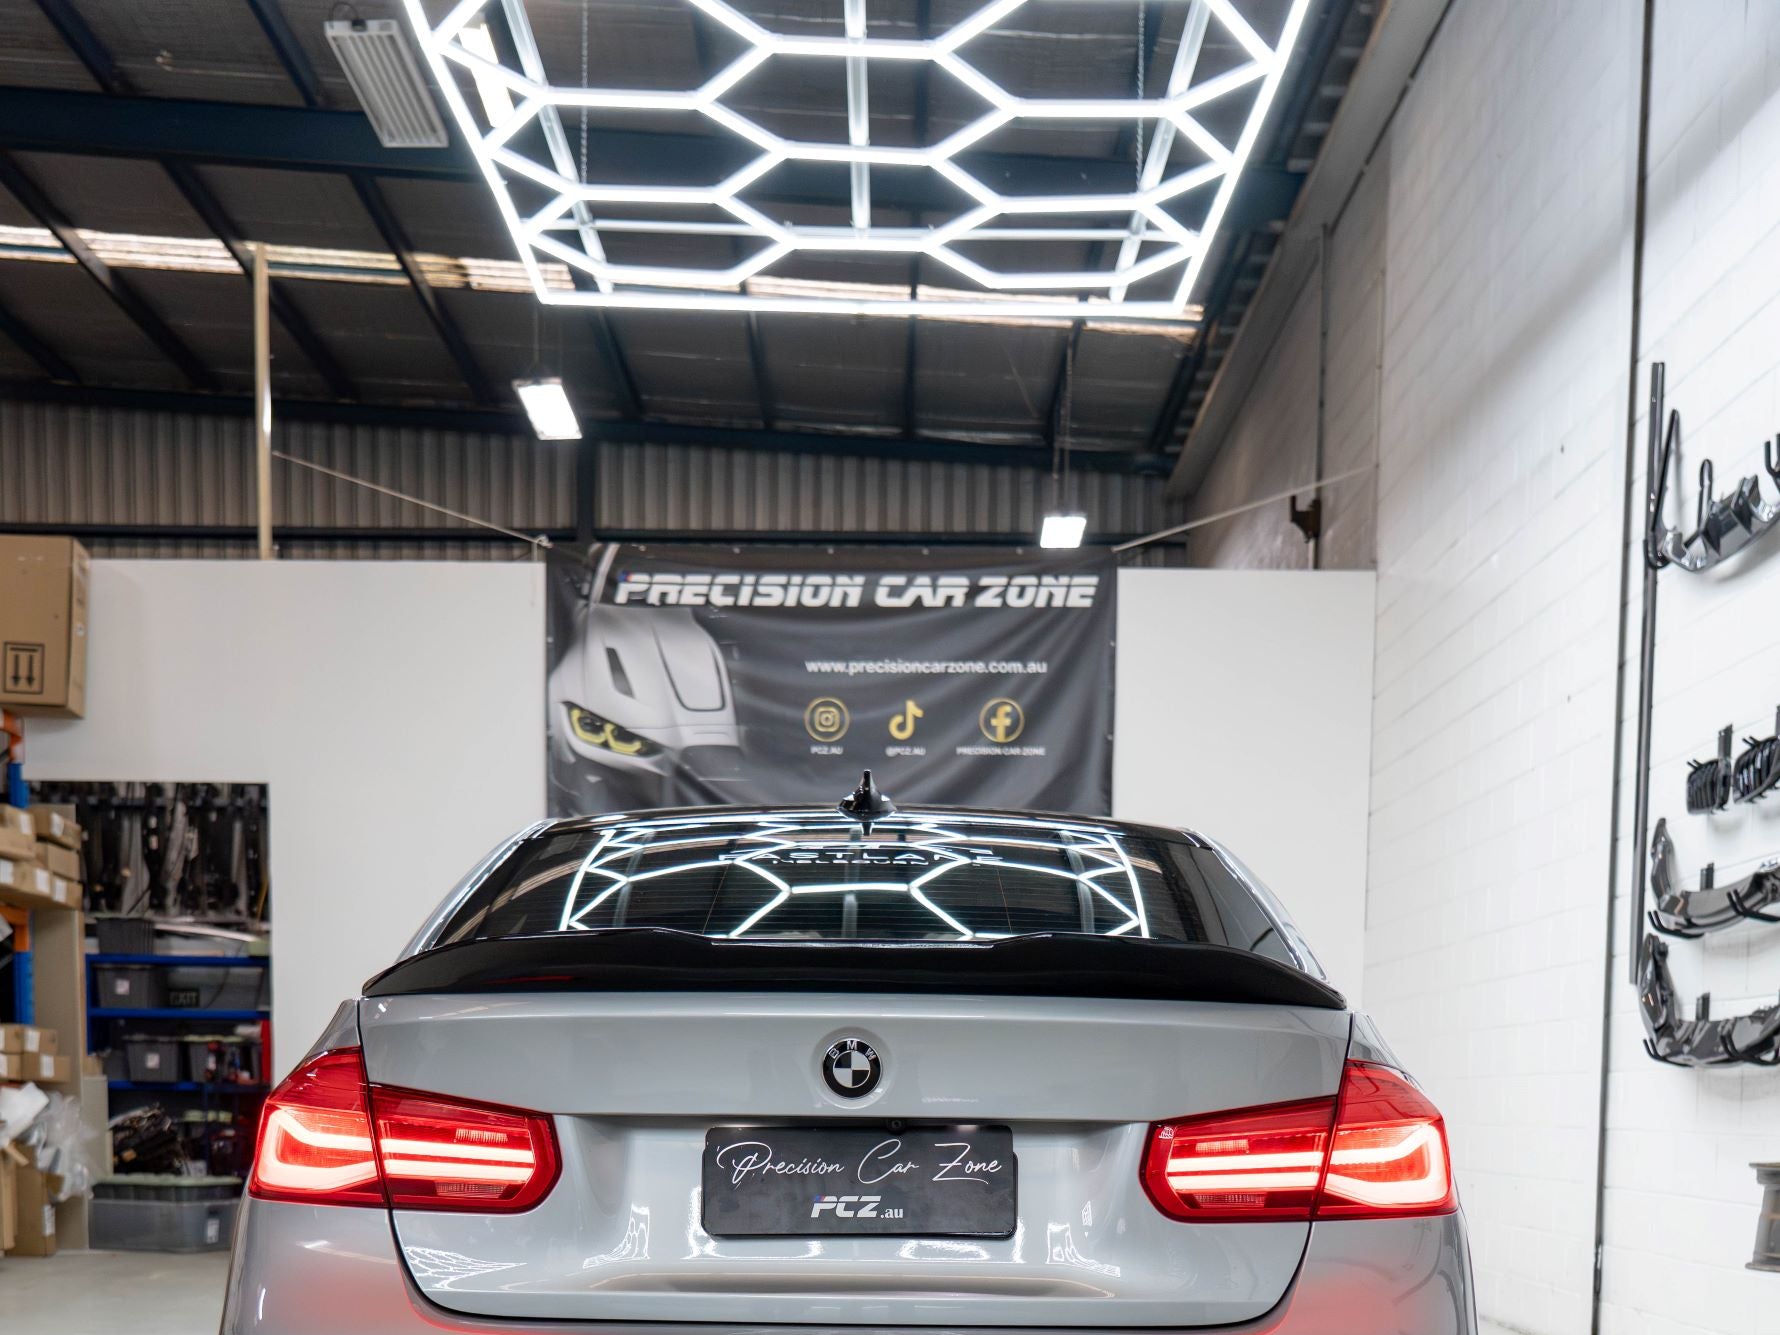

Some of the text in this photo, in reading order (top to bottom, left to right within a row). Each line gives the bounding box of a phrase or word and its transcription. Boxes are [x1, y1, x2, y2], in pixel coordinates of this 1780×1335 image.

[615, 573, 1099, 608] PRECISION CAR ZONE
[804, 659, 1048, 676] www.precisioncarzone.com.au
[828, 1039, 877, 1061] BMW
[716, 1138, 1002, 1186] Precision Car Zone
[811, 1195, 904, 1219] PCZ.au
